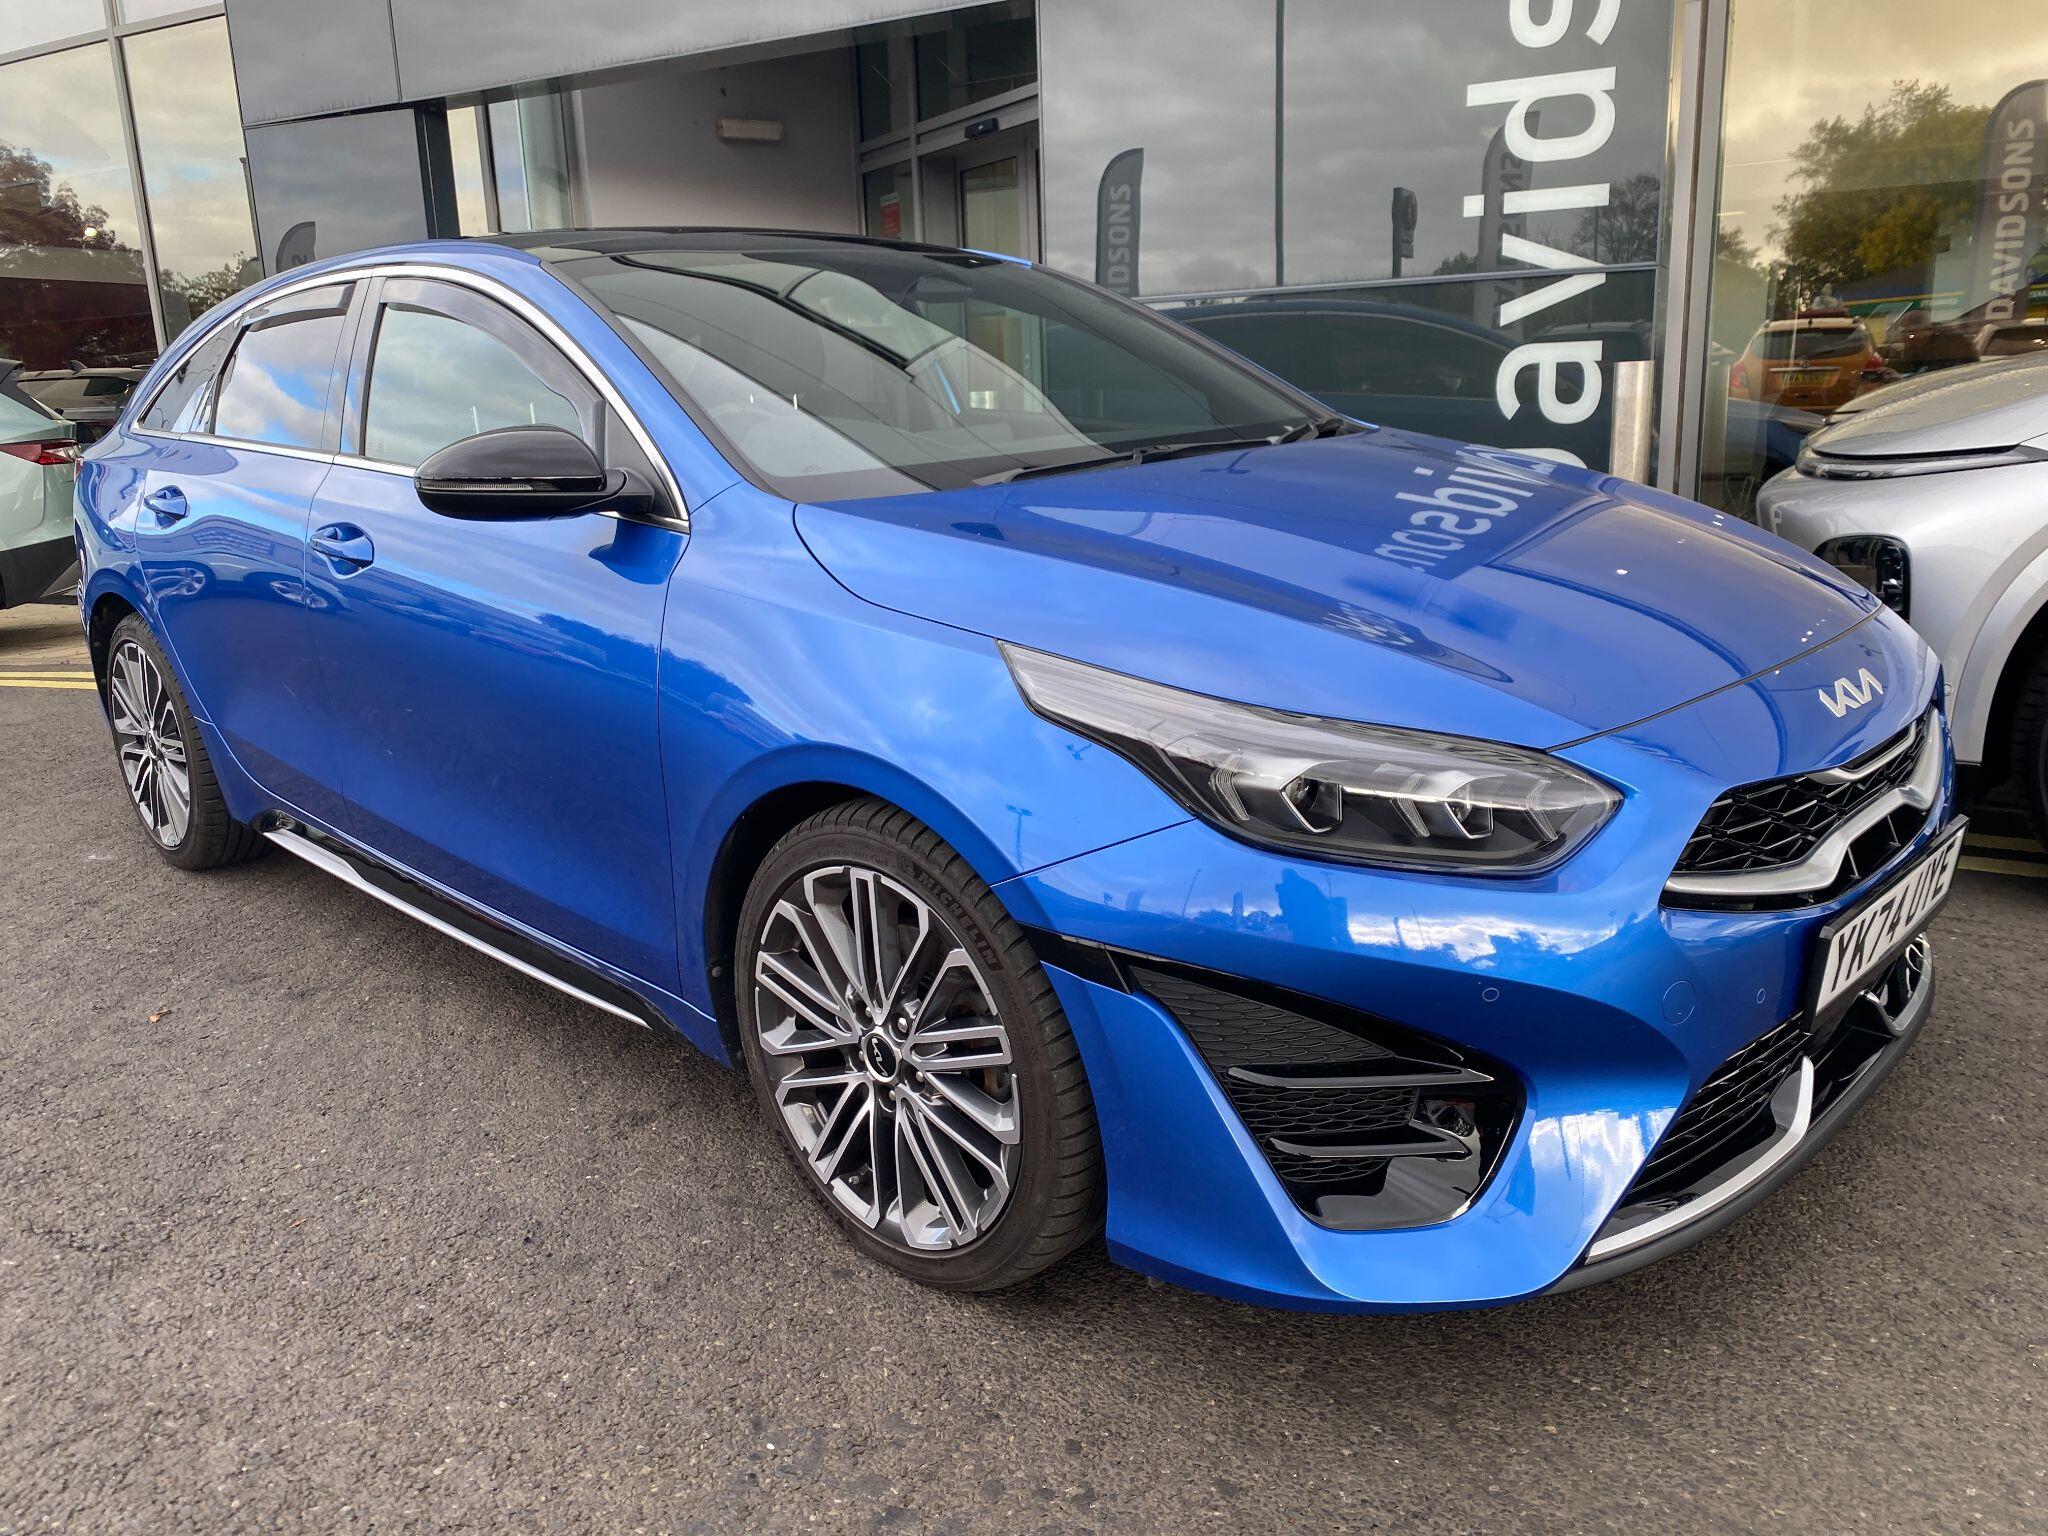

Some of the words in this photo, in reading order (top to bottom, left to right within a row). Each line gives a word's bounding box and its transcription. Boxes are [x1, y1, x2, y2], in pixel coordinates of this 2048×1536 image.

[1985, 118, 2036, 320] DAVIDSONS
[917, 871, 999, 968] MICHELIN
[1831, 884, 1910, 993] YK74
[1904, 836, 1958, 927] UYE
